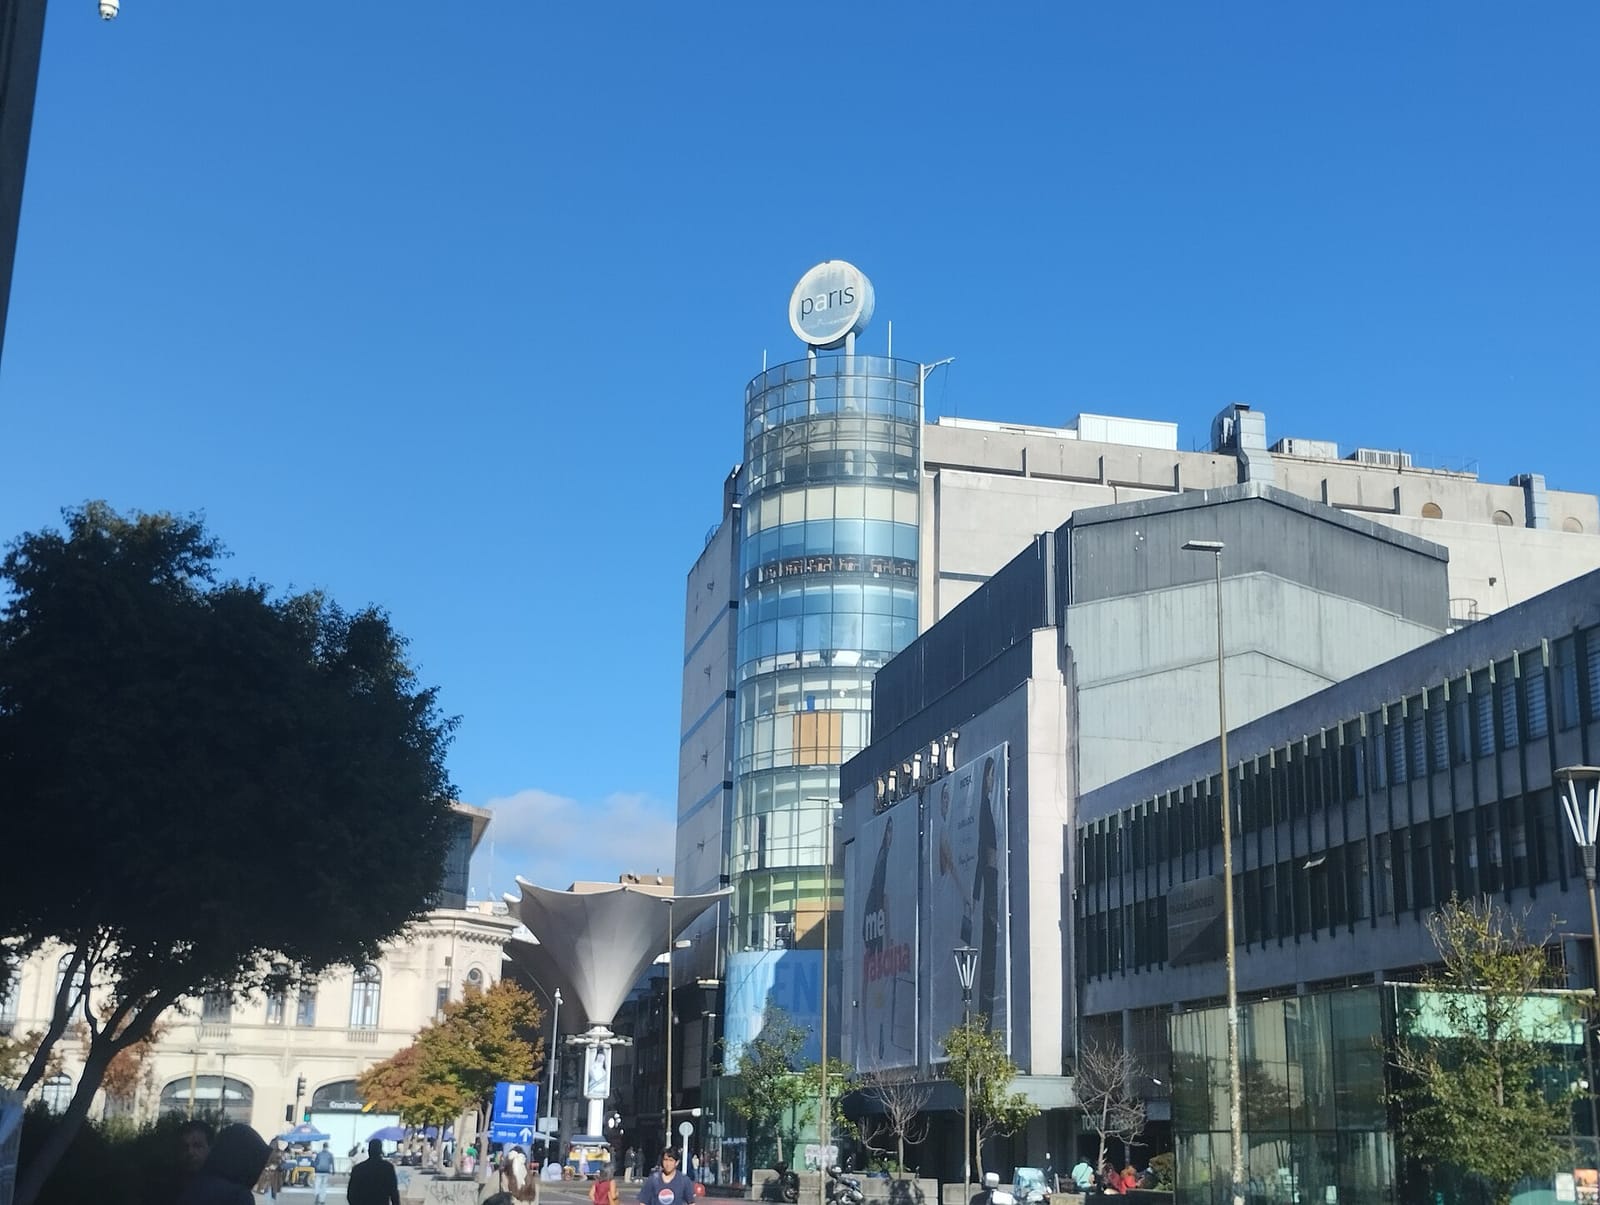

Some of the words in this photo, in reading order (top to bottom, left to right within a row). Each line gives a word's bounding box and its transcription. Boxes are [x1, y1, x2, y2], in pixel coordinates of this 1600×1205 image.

[801, 286, 855, 321] paris
[865, 908, 885, 942] me
[507, 1084, 526, 1113] E
